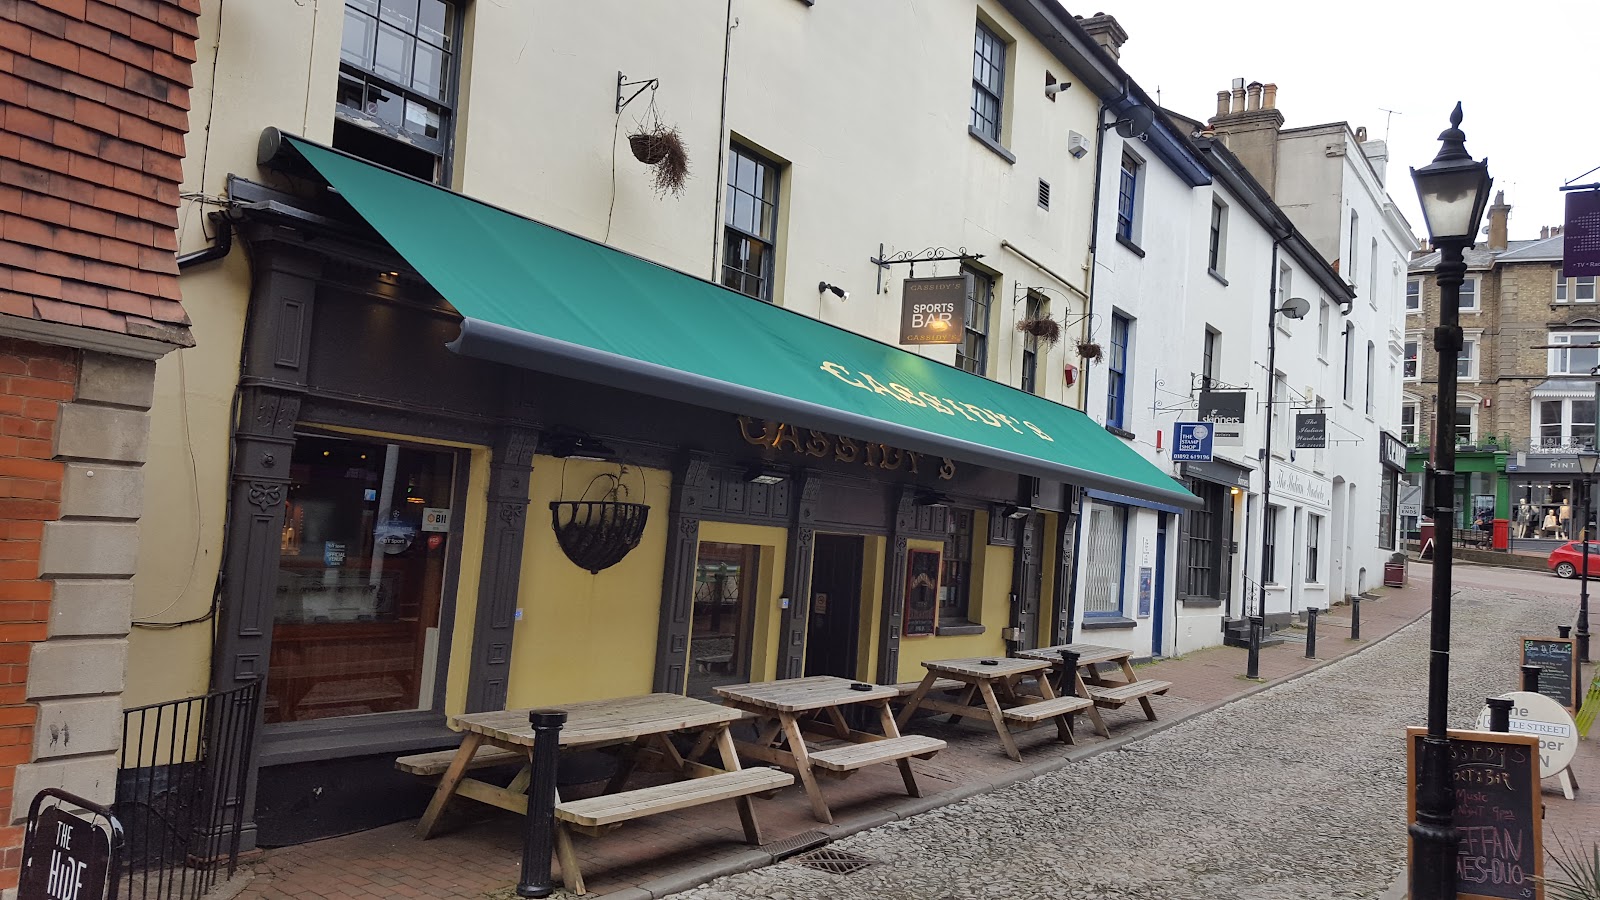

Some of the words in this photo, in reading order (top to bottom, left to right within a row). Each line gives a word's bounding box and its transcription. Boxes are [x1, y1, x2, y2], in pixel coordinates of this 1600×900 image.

[910, 283, 961, 291] CASSIDY'S
[913, 303, 954, 313] SPORTS
[911, 313, 953, 328] BAR
[820, 361, 1055, 442] CASSIDY'S
[1202, 414, 1240, 424] skinners
[1527, 723, 1567, 734] STREET
[55, 820, 74, 851] THE
